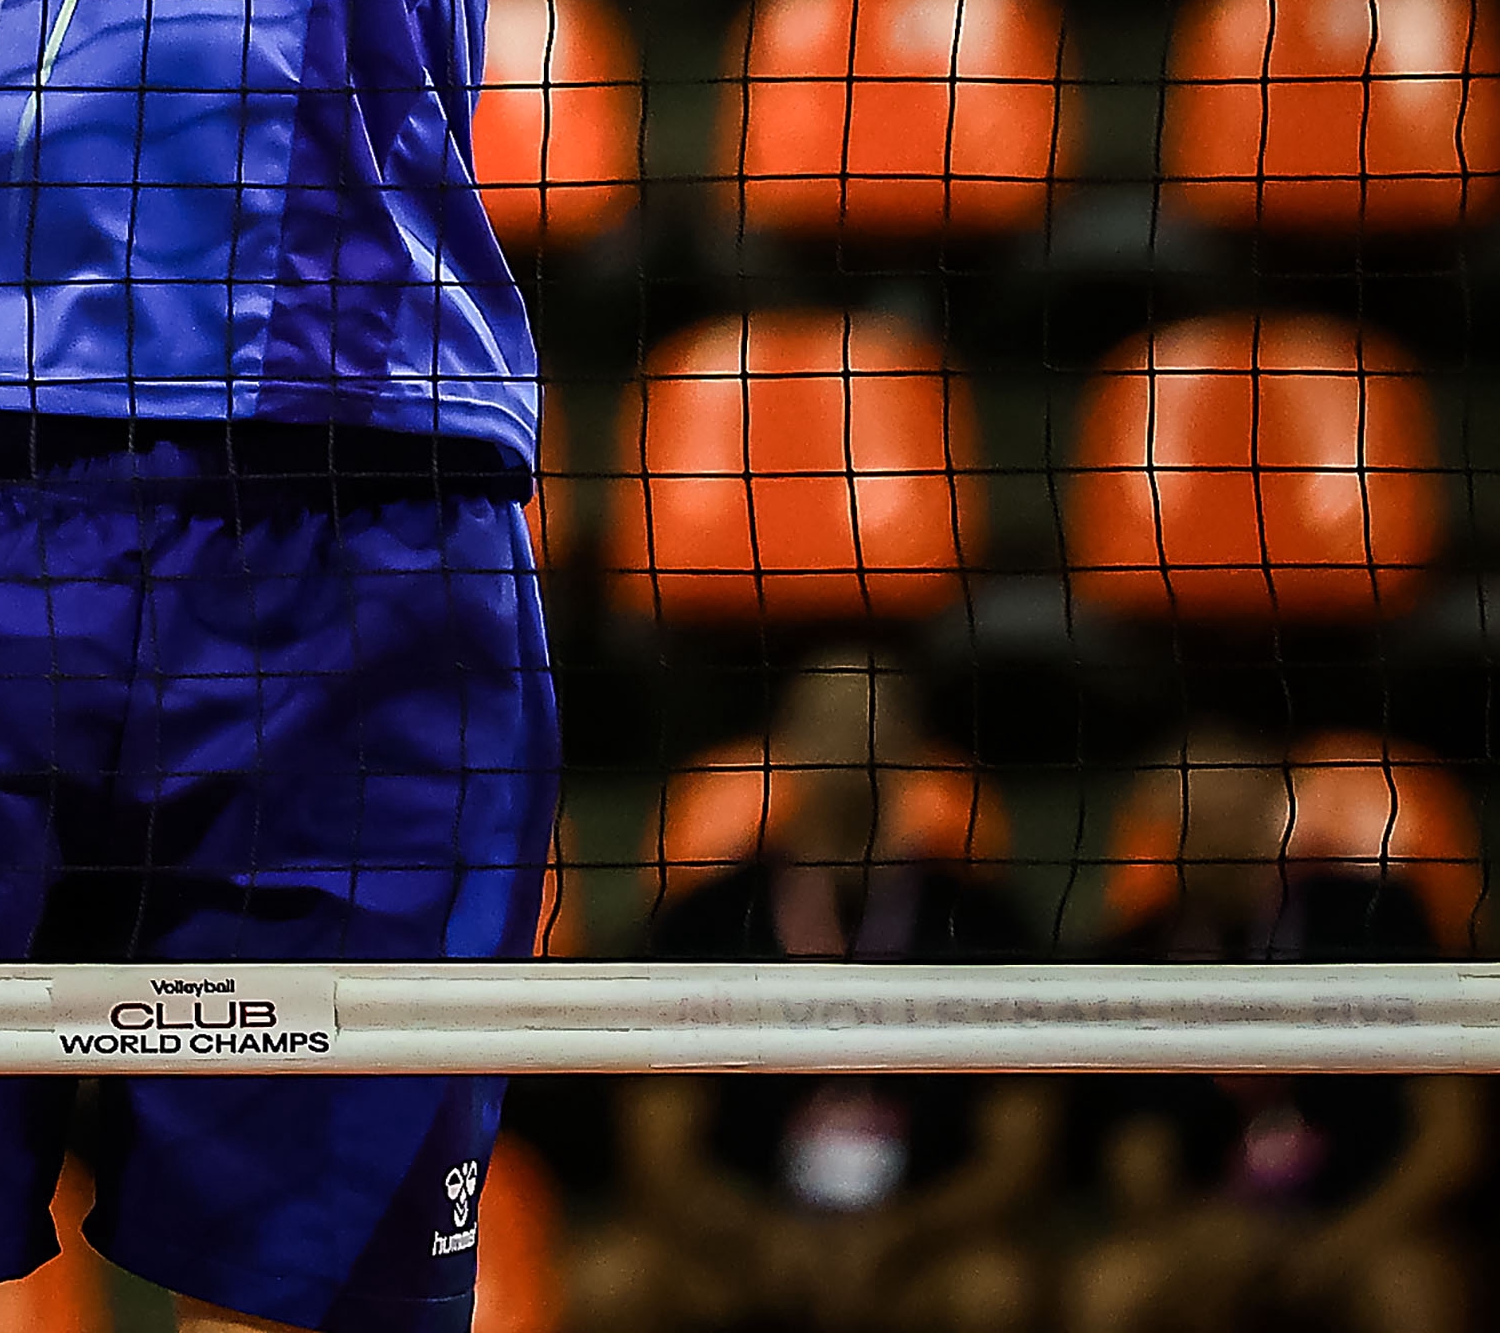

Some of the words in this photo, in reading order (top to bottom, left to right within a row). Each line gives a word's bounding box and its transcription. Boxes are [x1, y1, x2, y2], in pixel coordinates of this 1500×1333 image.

[150, 979, 236, 997] Volleyball
[110, 1001, 277, 1030] CLUB
[59, 1034, 182, 1054] WORLD
[189, 1032, 330, 1054] CHAMPS
